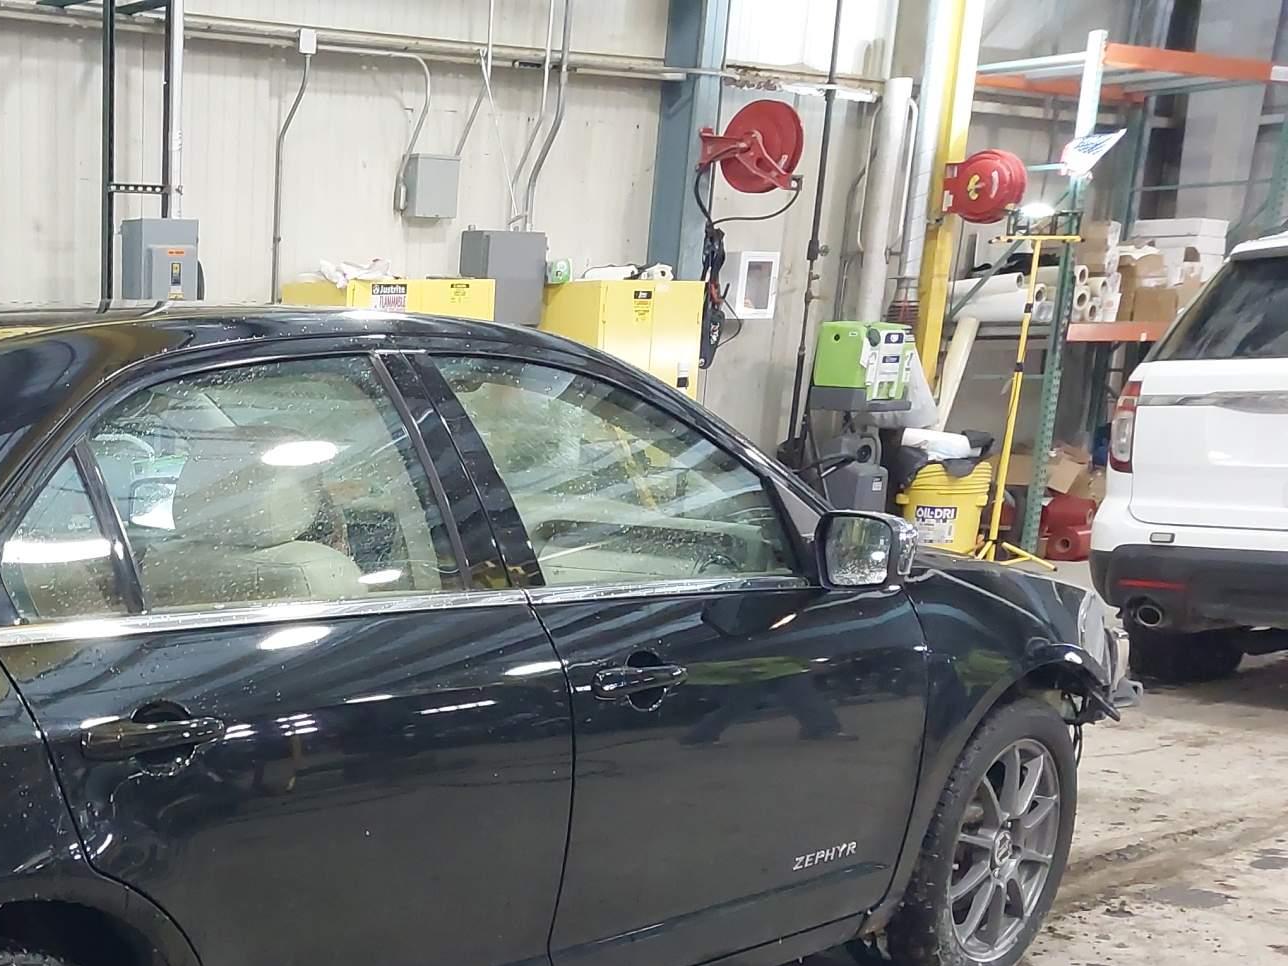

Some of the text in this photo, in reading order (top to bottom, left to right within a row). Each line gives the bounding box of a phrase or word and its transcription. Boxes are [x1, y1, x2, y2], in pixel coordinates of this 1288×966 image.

[380, 284, 405, 294] Justrite
[379, 295, 406, 308] FLAMMABLE
[793, 841, 857, 871] ZEPHYR
